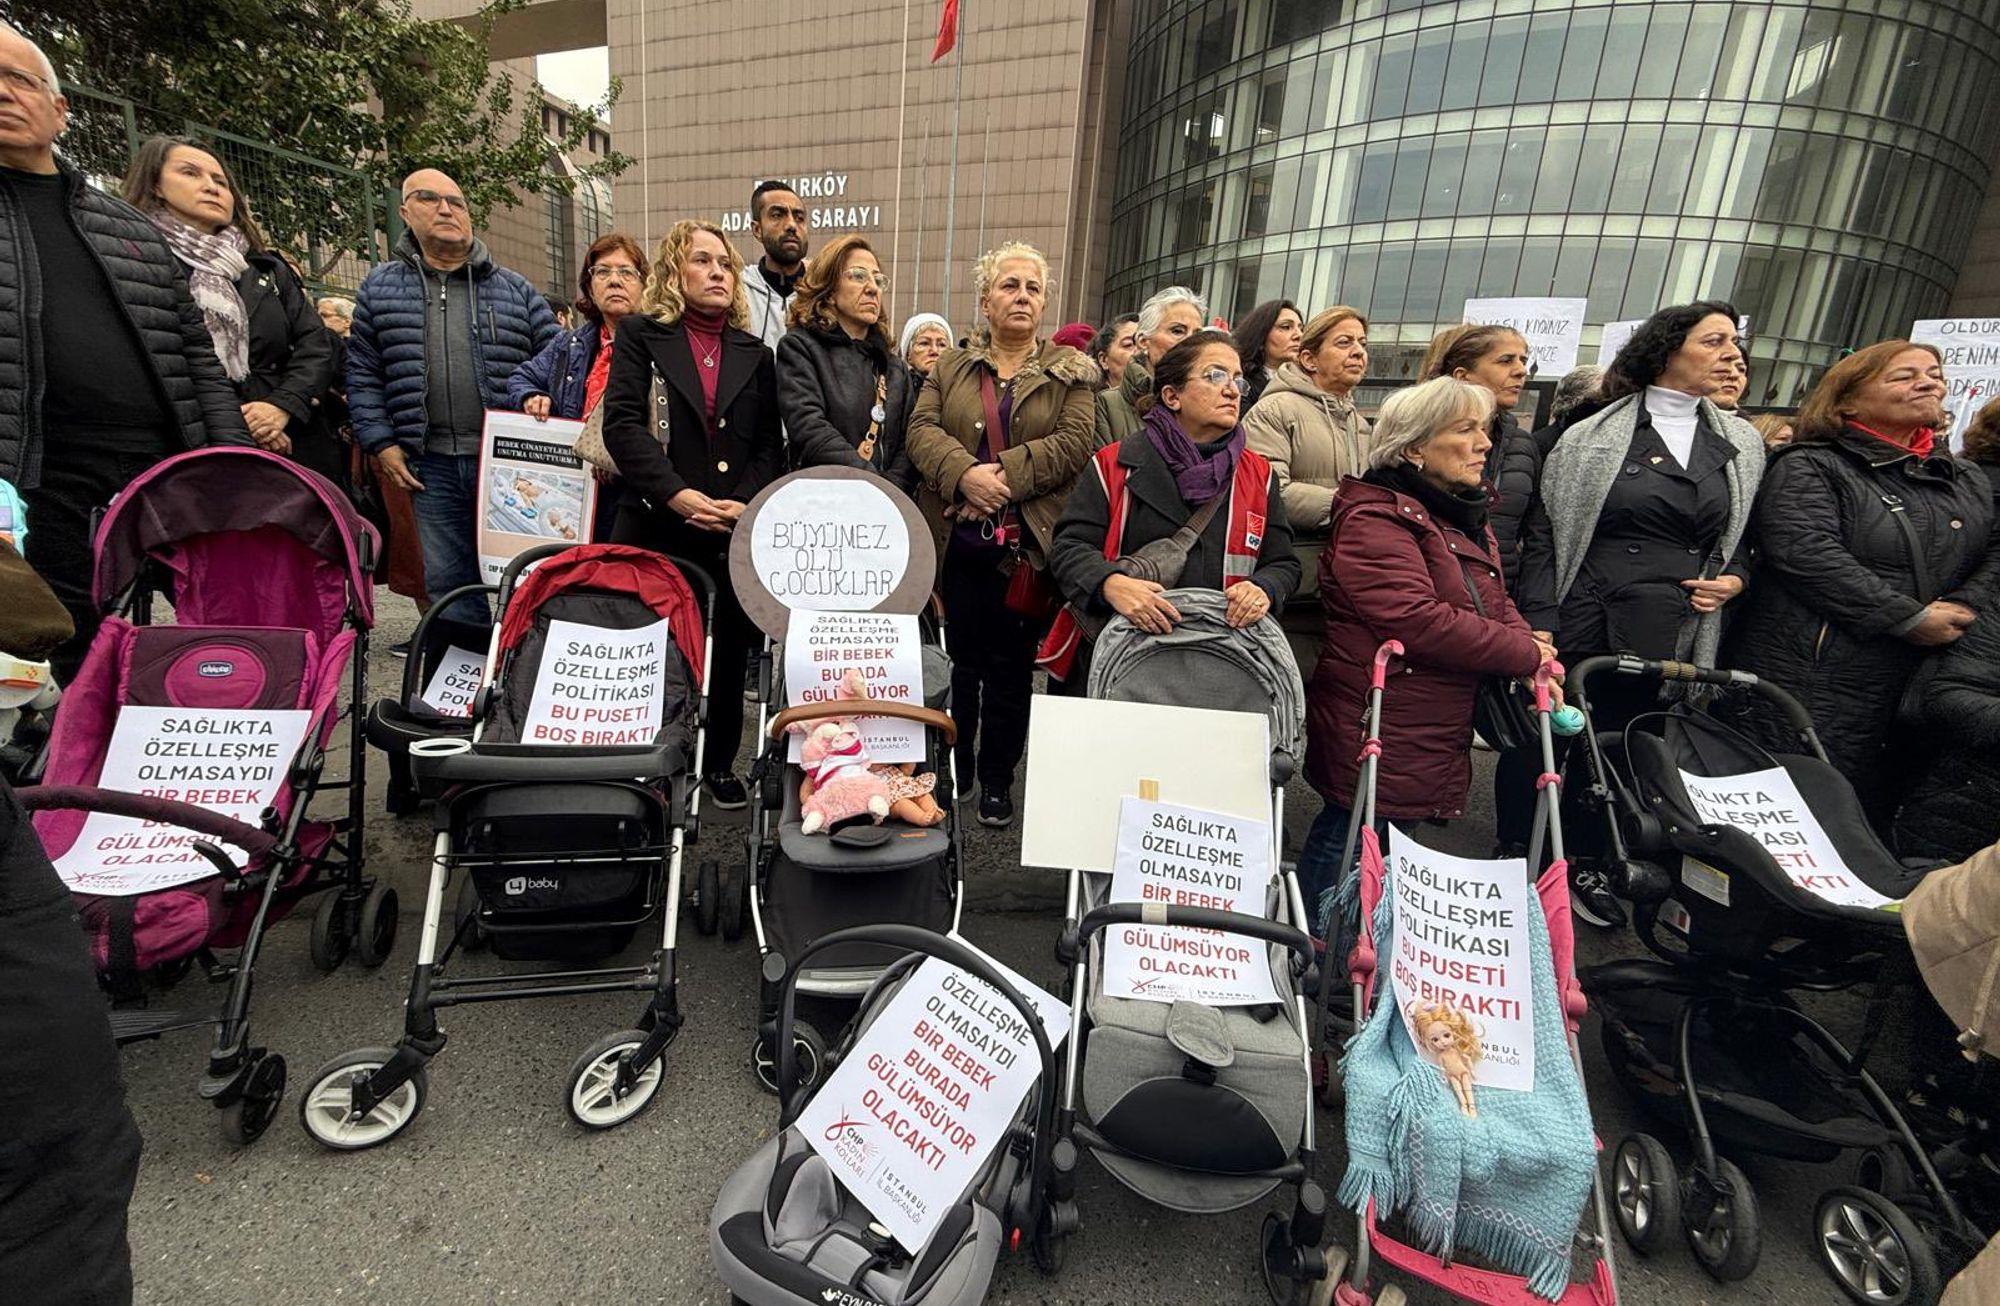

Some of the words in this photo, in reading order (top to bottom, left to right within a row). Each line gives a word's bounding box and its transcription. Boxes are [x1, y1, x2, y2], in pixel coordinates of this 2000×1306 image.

[721, 212, 752, 232] ADA
[811, 206, 879, 229] SARAYI
[1943, 343, 1999, 366] BENİM
[772, 520, 890, 550] BÜYÜMEZ
[769, 569, 893, 597] ÇOCUKLAR
[810, 624, 900, 635] ÖZELLEŞME
[817, 614, 892, 625] SAĞLIKTA
[566, 641, 655, 661] SAĞLIKTA
[809, 635, 900, 645] OLMASAYDI
[813, 648, 839, 662] BİR
[843, 647, 895, 661] BEBEK
[553, 657, 659, 683] ÖZELLEŞME
[551, 682, 655, 702] POLİTİKASI
[551, 704, 579, 721] BU
[583, 701, 649, 723] PUSETİ
[161, 716, 273, 735] SAĞLIKTA
[534, 724, 577, 744] BOŞ
[581, 725, 655, 745] BIRAKTI
[144, 737, 280, 762] ÖZELLEŞME
[138, 764, 274, 781] OLMASAYDI
[184, 788, 262, 805] BEBEK
[1151, 813, 1238, 844] SAĞLIKTA
[102, 852, 205, 866] OLACAK
[1142, 830, 1244, 868] ÖZELLEŞME
[528, 876, 559, 890] baby
[1139, 859, 1242, 893] OLMASAYDI
[1399, 855, 1502, 900] SAĞLIKTA
[1142, 881, 1171, 903] BİR
[1176, 889, 1235, 913] BEBEK
[1397, 873, 1514, 930] ÖZELLEŞME
[1399, 905, 1510, 958] POLİTİKASI
[1123, 927, 1251, 964] GÜLÜMSÜYOR
[1138, 956, 1238, 981] OLACAKTI
[1402, 936, 1416, 962] BU
[1419, 950, 1506, 988] PUSETİ
[1395, 958, 1418, 997] BOŞ
[1421, 979, 1521, 1021] BIRAKTI
[941, 972, 1033, 1047] ÖZELLEŞME
[926, 995, 1018, 1070] OLMASAYDI
[913, 1019, 944, 1052] BİR
[941, 1043, 997, 1092] BEBEK
[903, 1048, 971, 1112] BURADA
[867, 1053, 976, 1155] GÜLÜMSÜYOR
[846, 1127, 864, 1145] CHP
[862, 1088, 947, 1172] OLACAKTI
